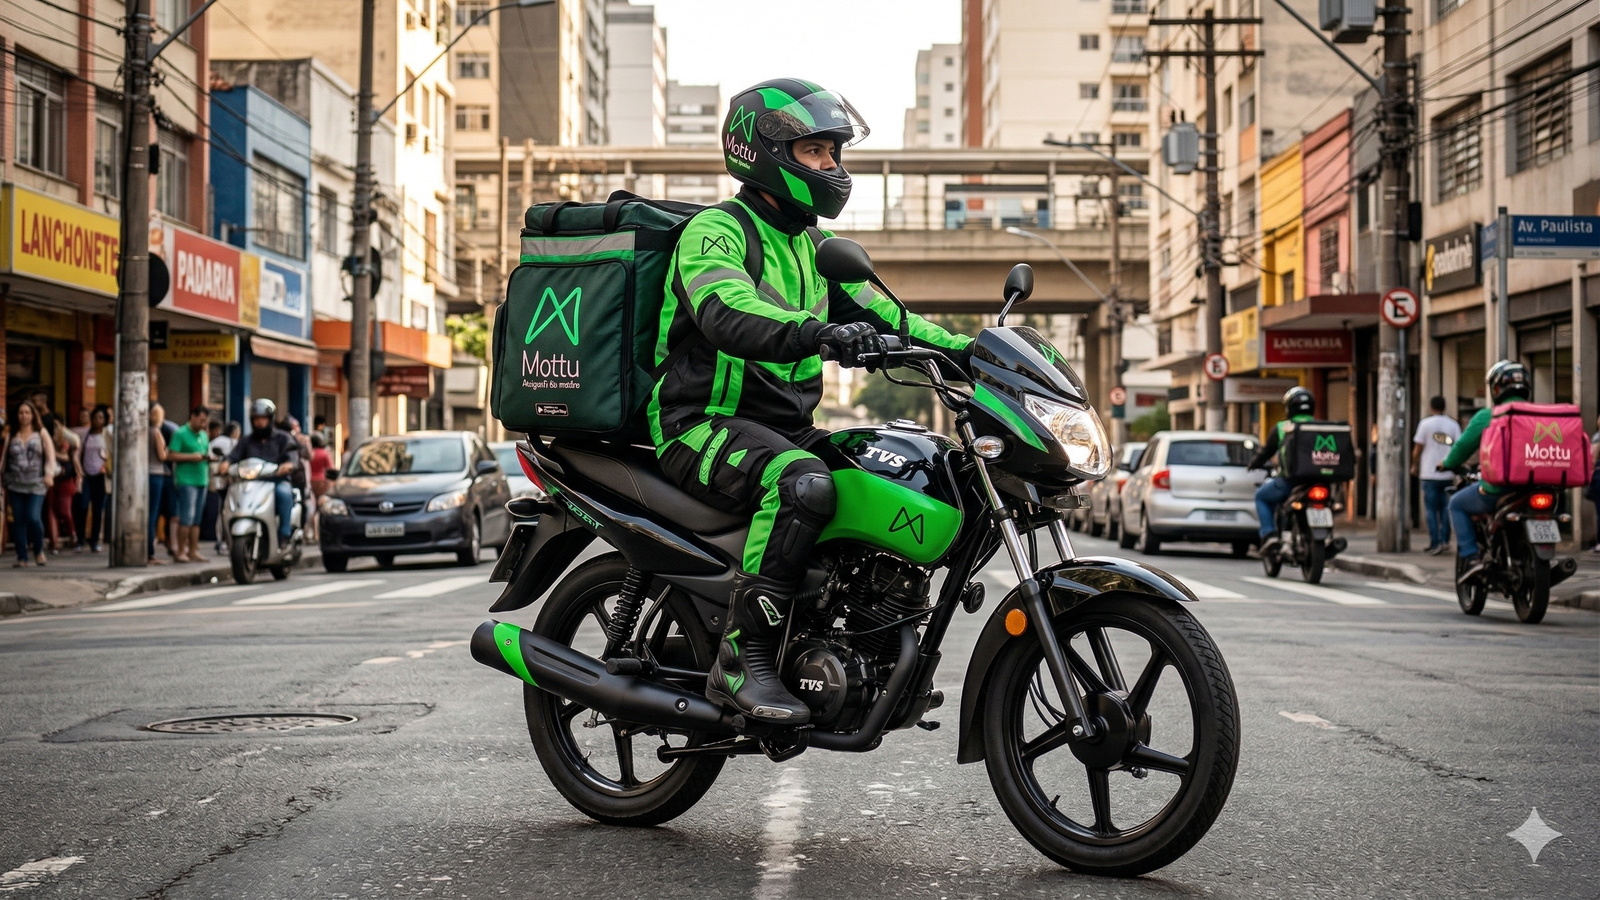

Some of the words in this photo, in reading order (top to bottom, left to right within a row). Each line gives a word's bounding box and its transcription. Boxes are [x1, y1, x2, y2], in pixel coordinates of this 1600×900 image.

[725, 133, 757, 162] Mottu
[1518, 219, 1537, 233] Av.
[1541, 219, 1593, 233] Paulista
[21, 208, 118, 277] LANCHONETE
[177, 250, 235, 304] PADARIA
[521, 349, 580, 378] Mottu
[864, 446, 908, 468] TVS
[1525, 443, 1571, 460] Mottu
[800, 678, 824, 691] TVS
